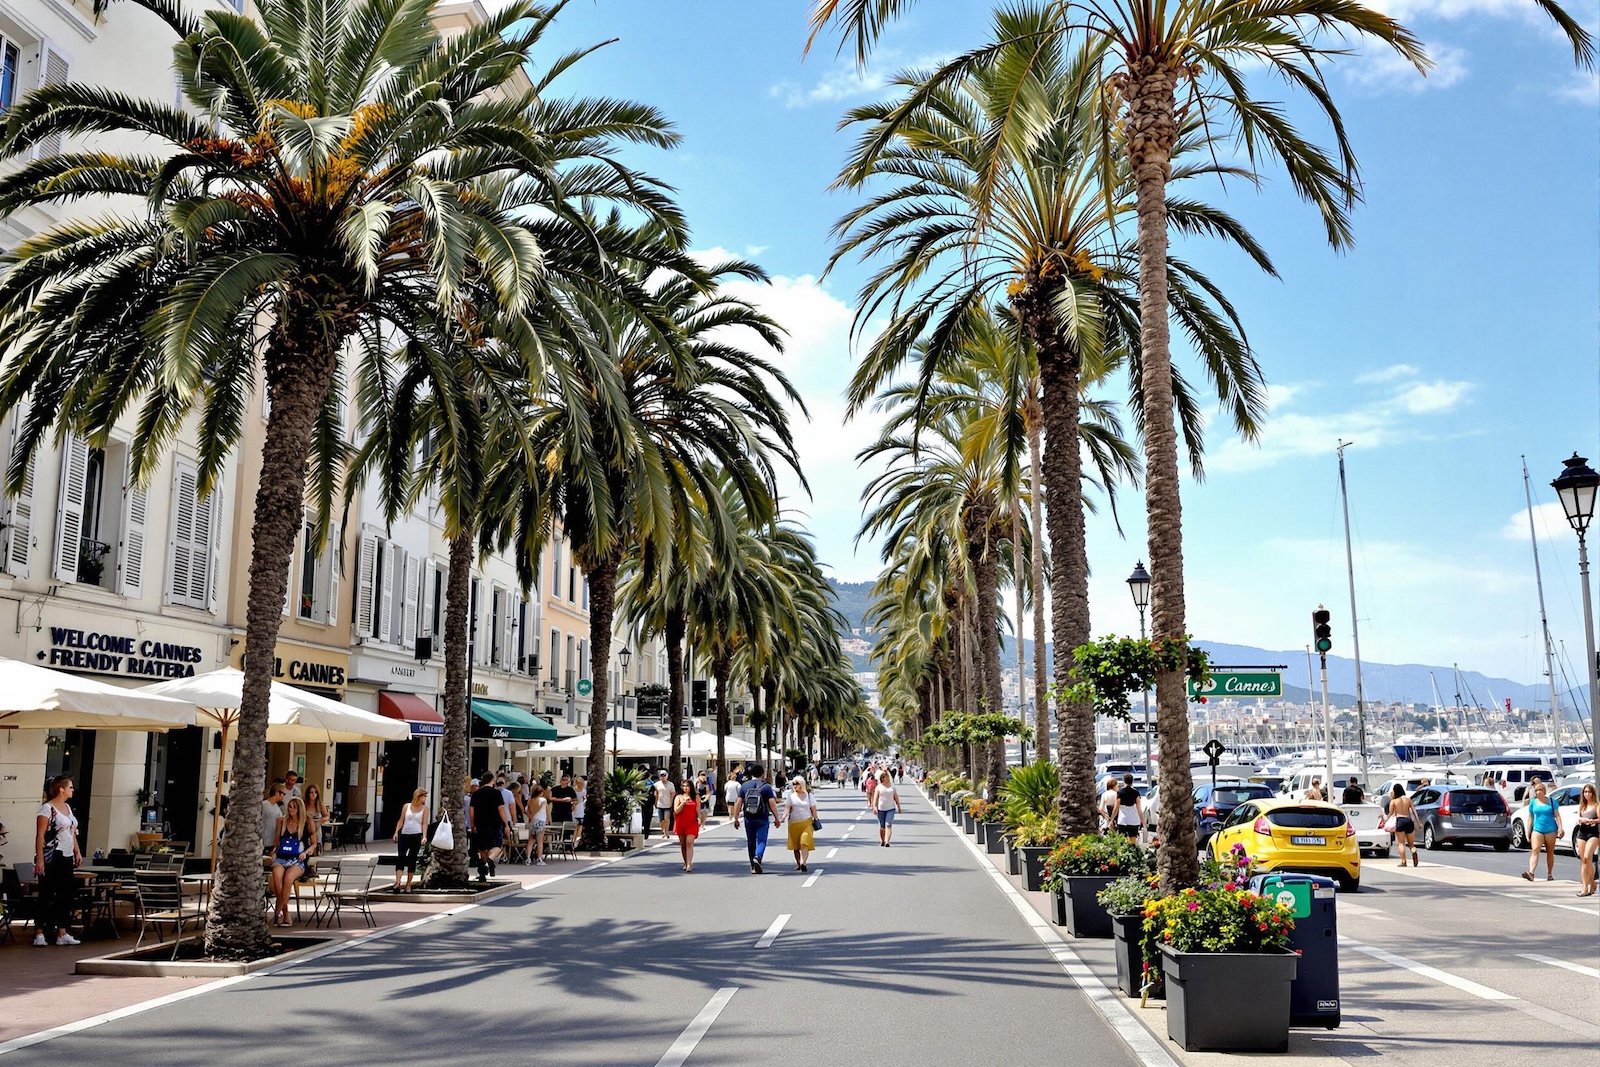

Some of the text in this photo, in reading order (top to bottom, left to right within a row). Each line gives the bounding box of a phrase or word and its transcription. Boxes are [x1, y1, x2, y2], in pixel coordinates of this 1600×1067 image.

[50, 626, 202, 663] WELCOME CANNES
[50, 648, 123, 672] FRENDY
[289, 660, 345, 686] CANNES
[1225, 676, 1276, 693] Cannes
